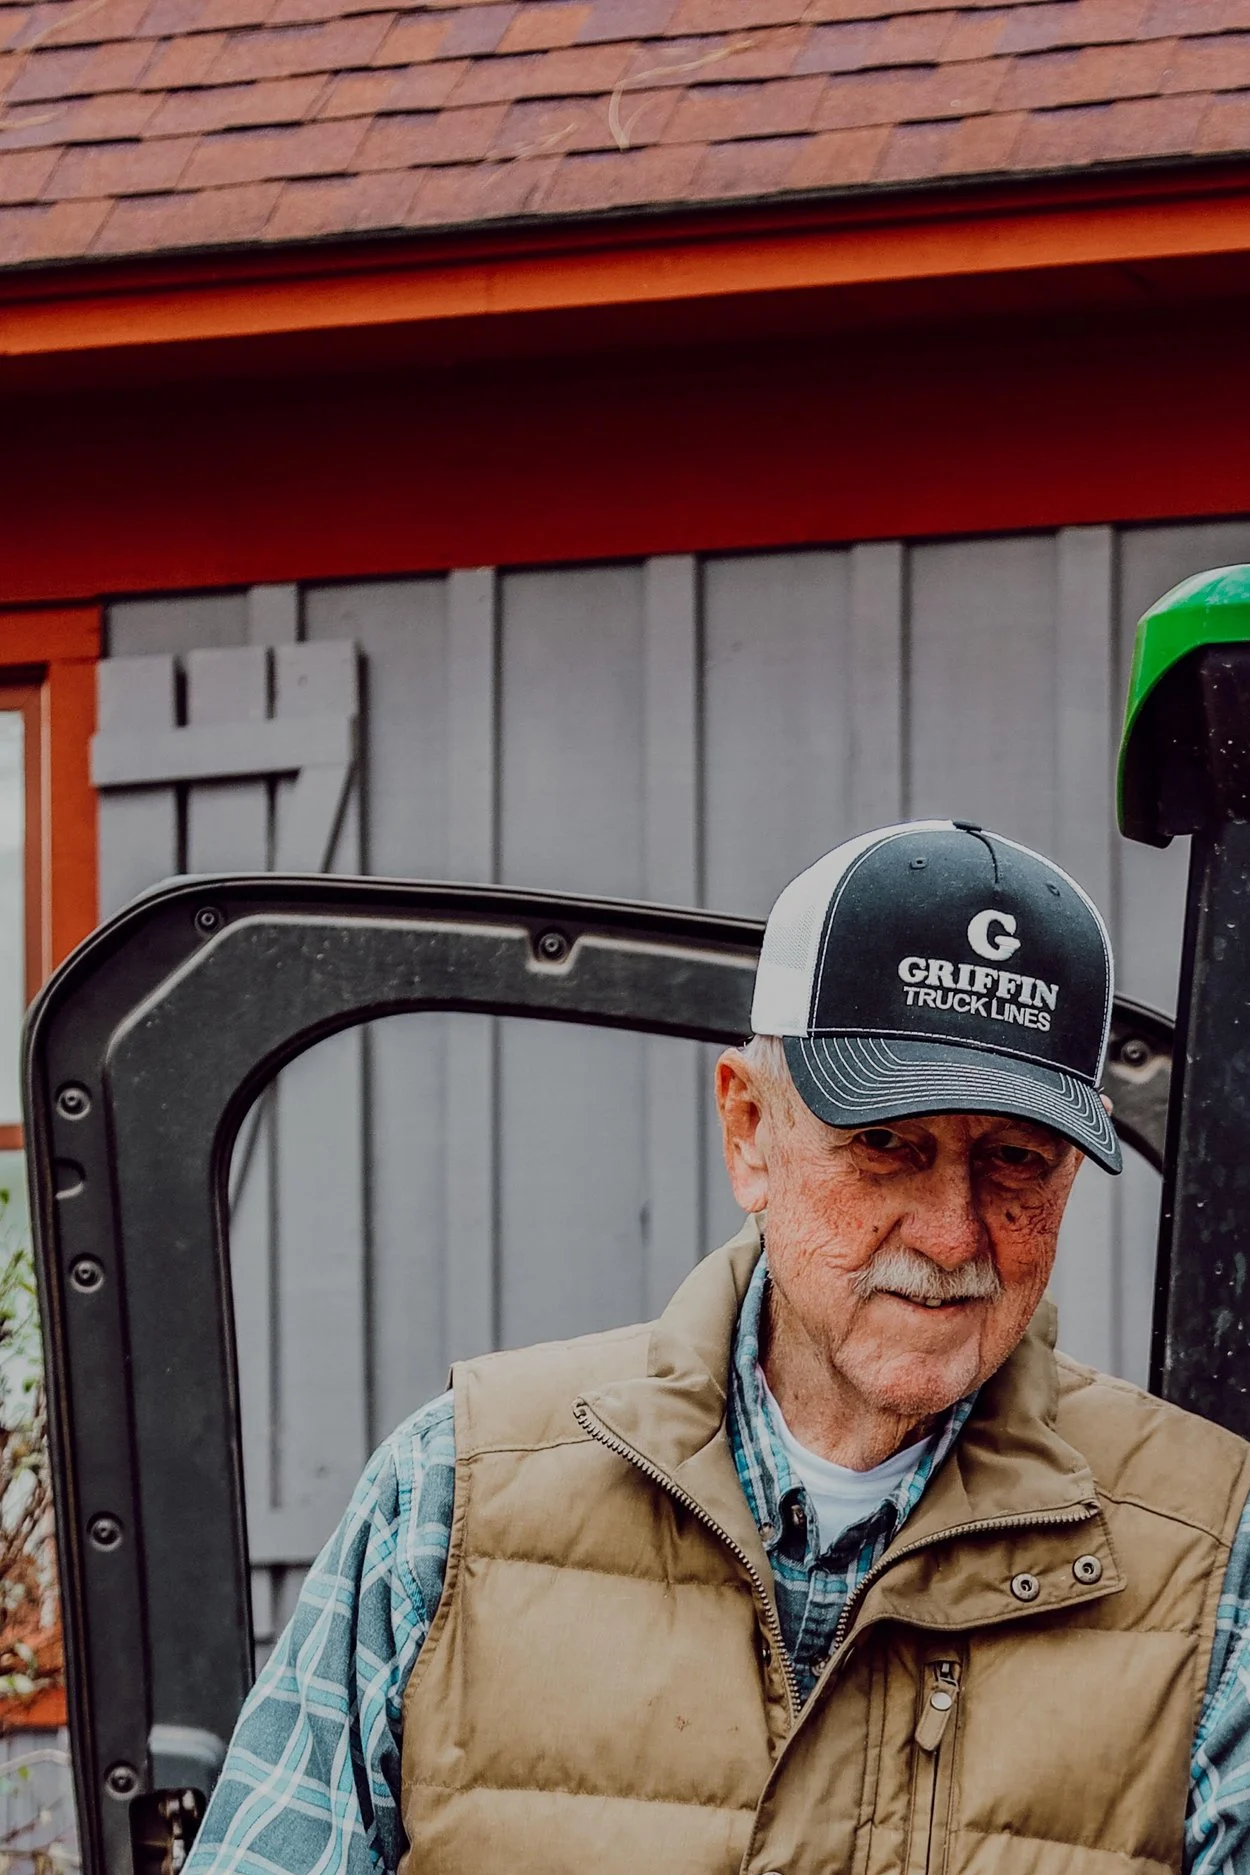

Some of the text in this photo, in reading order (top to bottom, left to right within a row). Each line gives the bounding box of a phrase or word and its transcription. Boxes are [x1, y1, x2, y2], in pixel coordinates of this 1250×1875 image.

[967, 909, 1021, 961] G
[898, 956, 1060, 1011] GRIFFIN
[904, 986, 1051, 1032] TRUCK LINES
